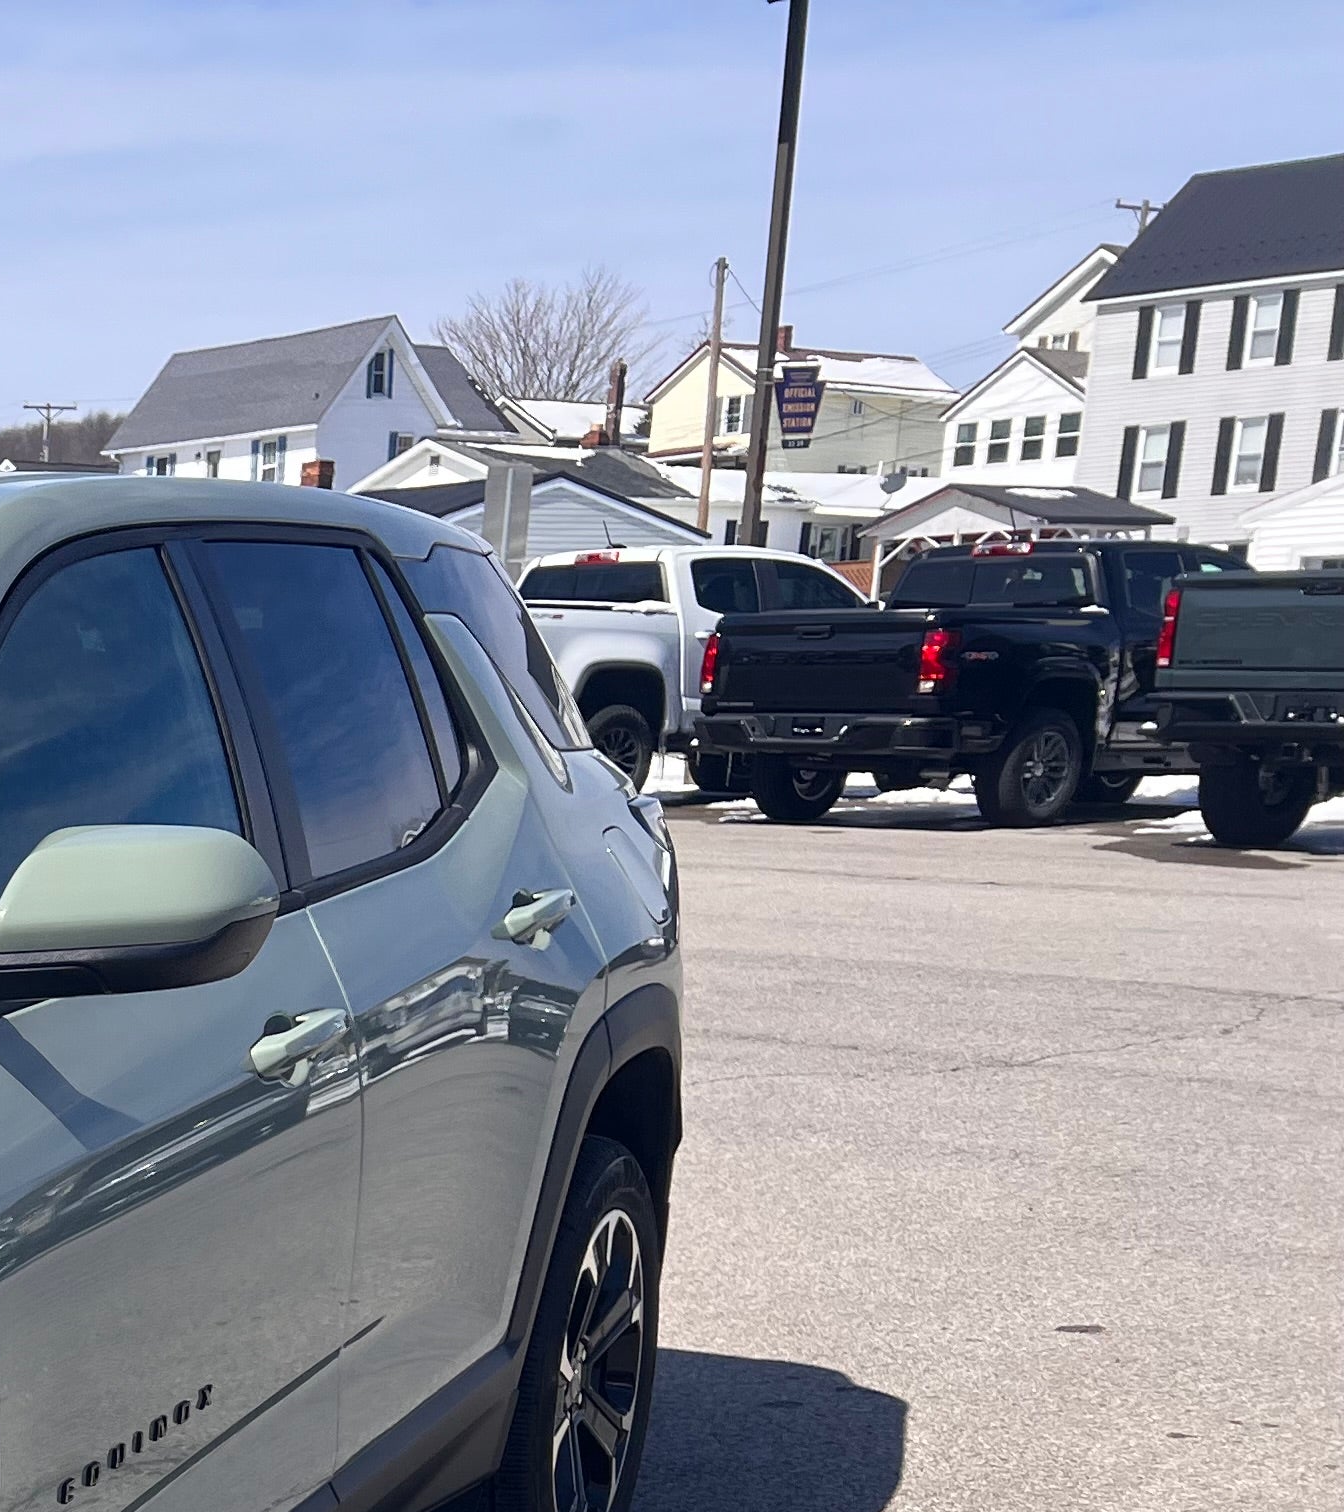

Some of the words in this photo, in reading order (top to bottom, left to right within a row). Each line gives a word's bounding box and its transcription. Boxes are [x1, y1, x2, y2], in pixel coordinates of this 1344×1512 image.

[784, 387, 816, 398] OFFICIAL
[782, 417, 812, 428] STATION
[56, 1383, 213, 1505] EQUINOX
